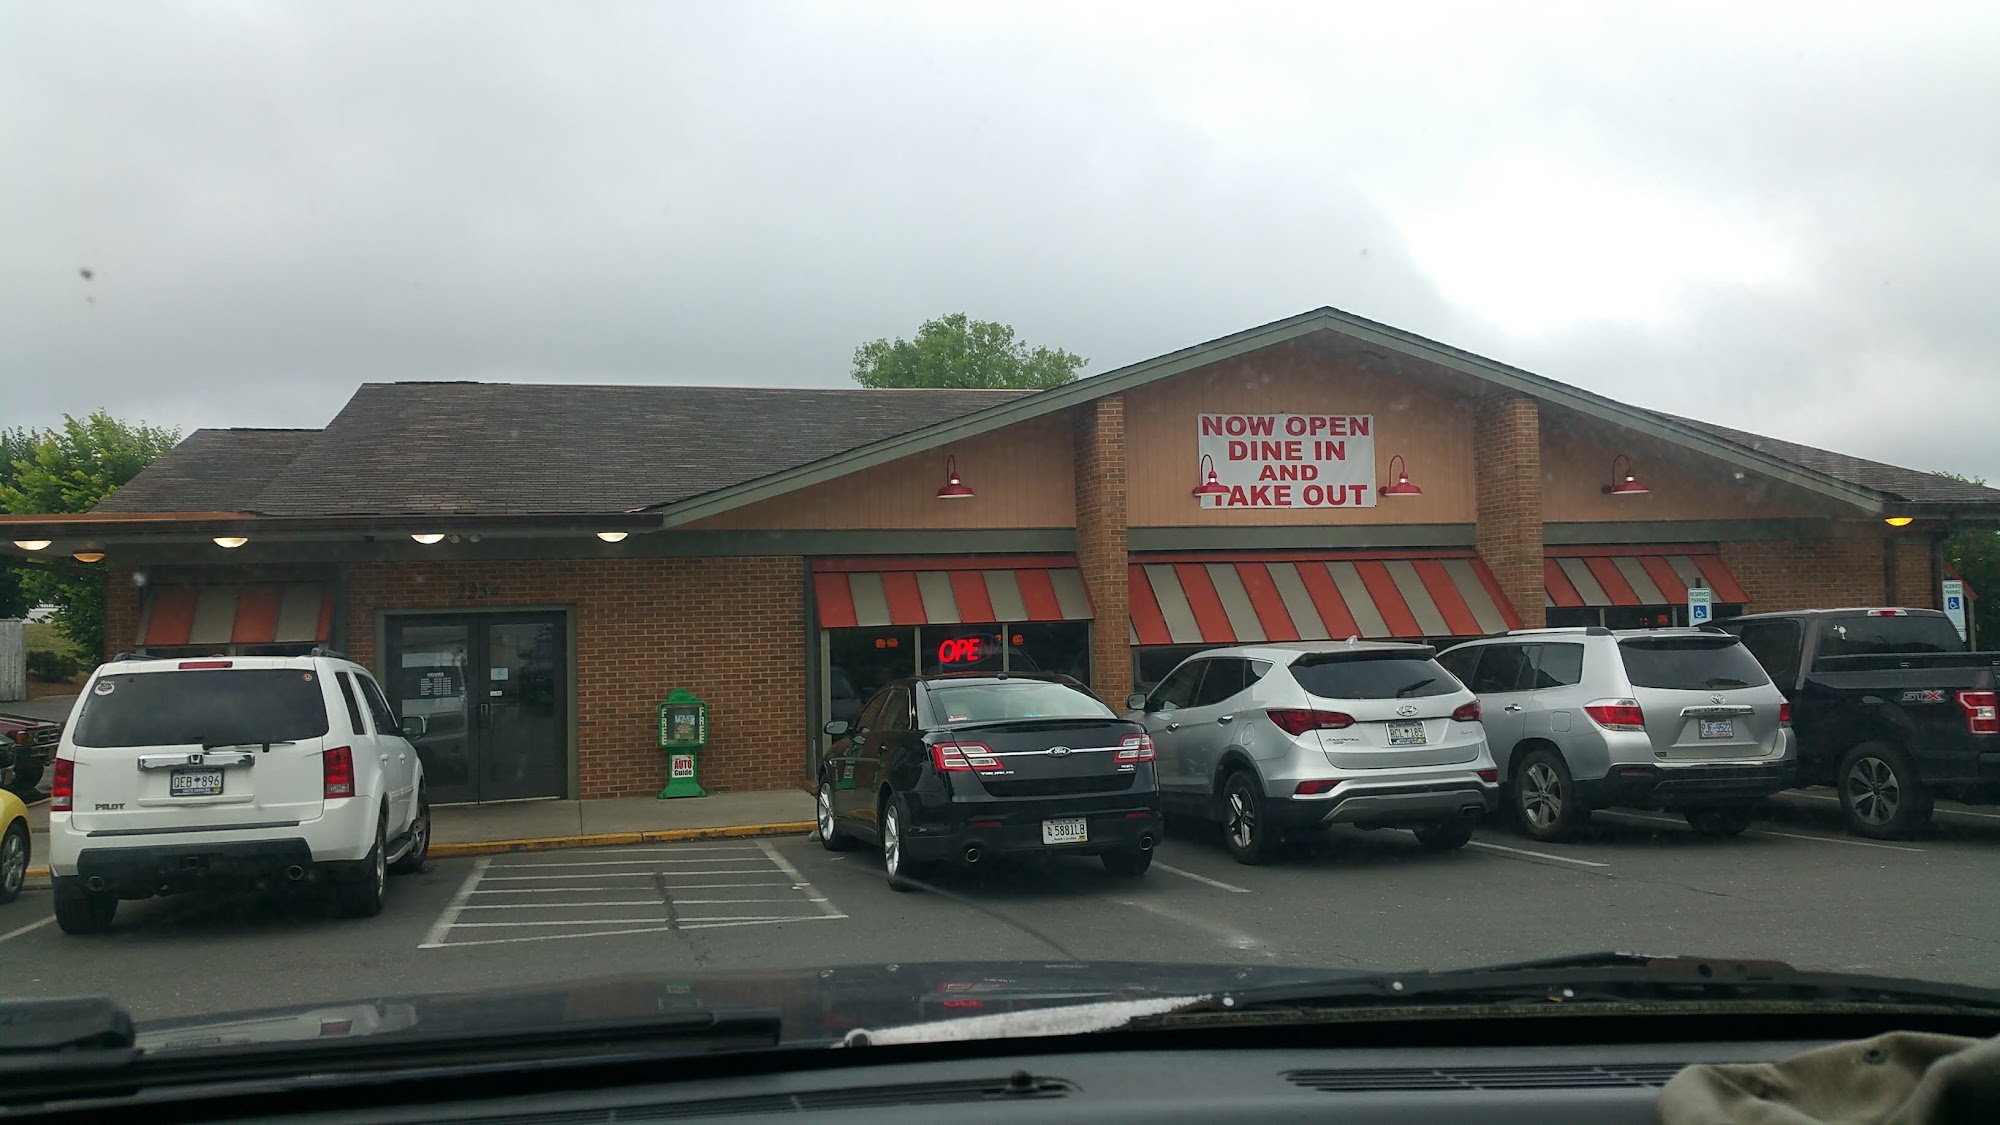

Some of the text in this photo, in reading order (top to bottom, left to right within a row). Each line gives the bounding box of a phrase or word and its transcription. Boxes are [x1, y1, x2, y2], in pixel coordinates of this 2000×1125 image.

[1202, 416, 1370, 437] NOW OPEN
[1228, 440, 1346, 461] DINE IN
[1258, 464, 1319, 481] AND
[1302, 484, 1368, 506] OUT
[1902, 690, 1945, 703] STX
[674, 760, 692, 769] AUTO
[674, 769, 692, 777] Guide
[173, 775, 220, 789] QEB 896
[95, 803, 125, 811] PILOT
